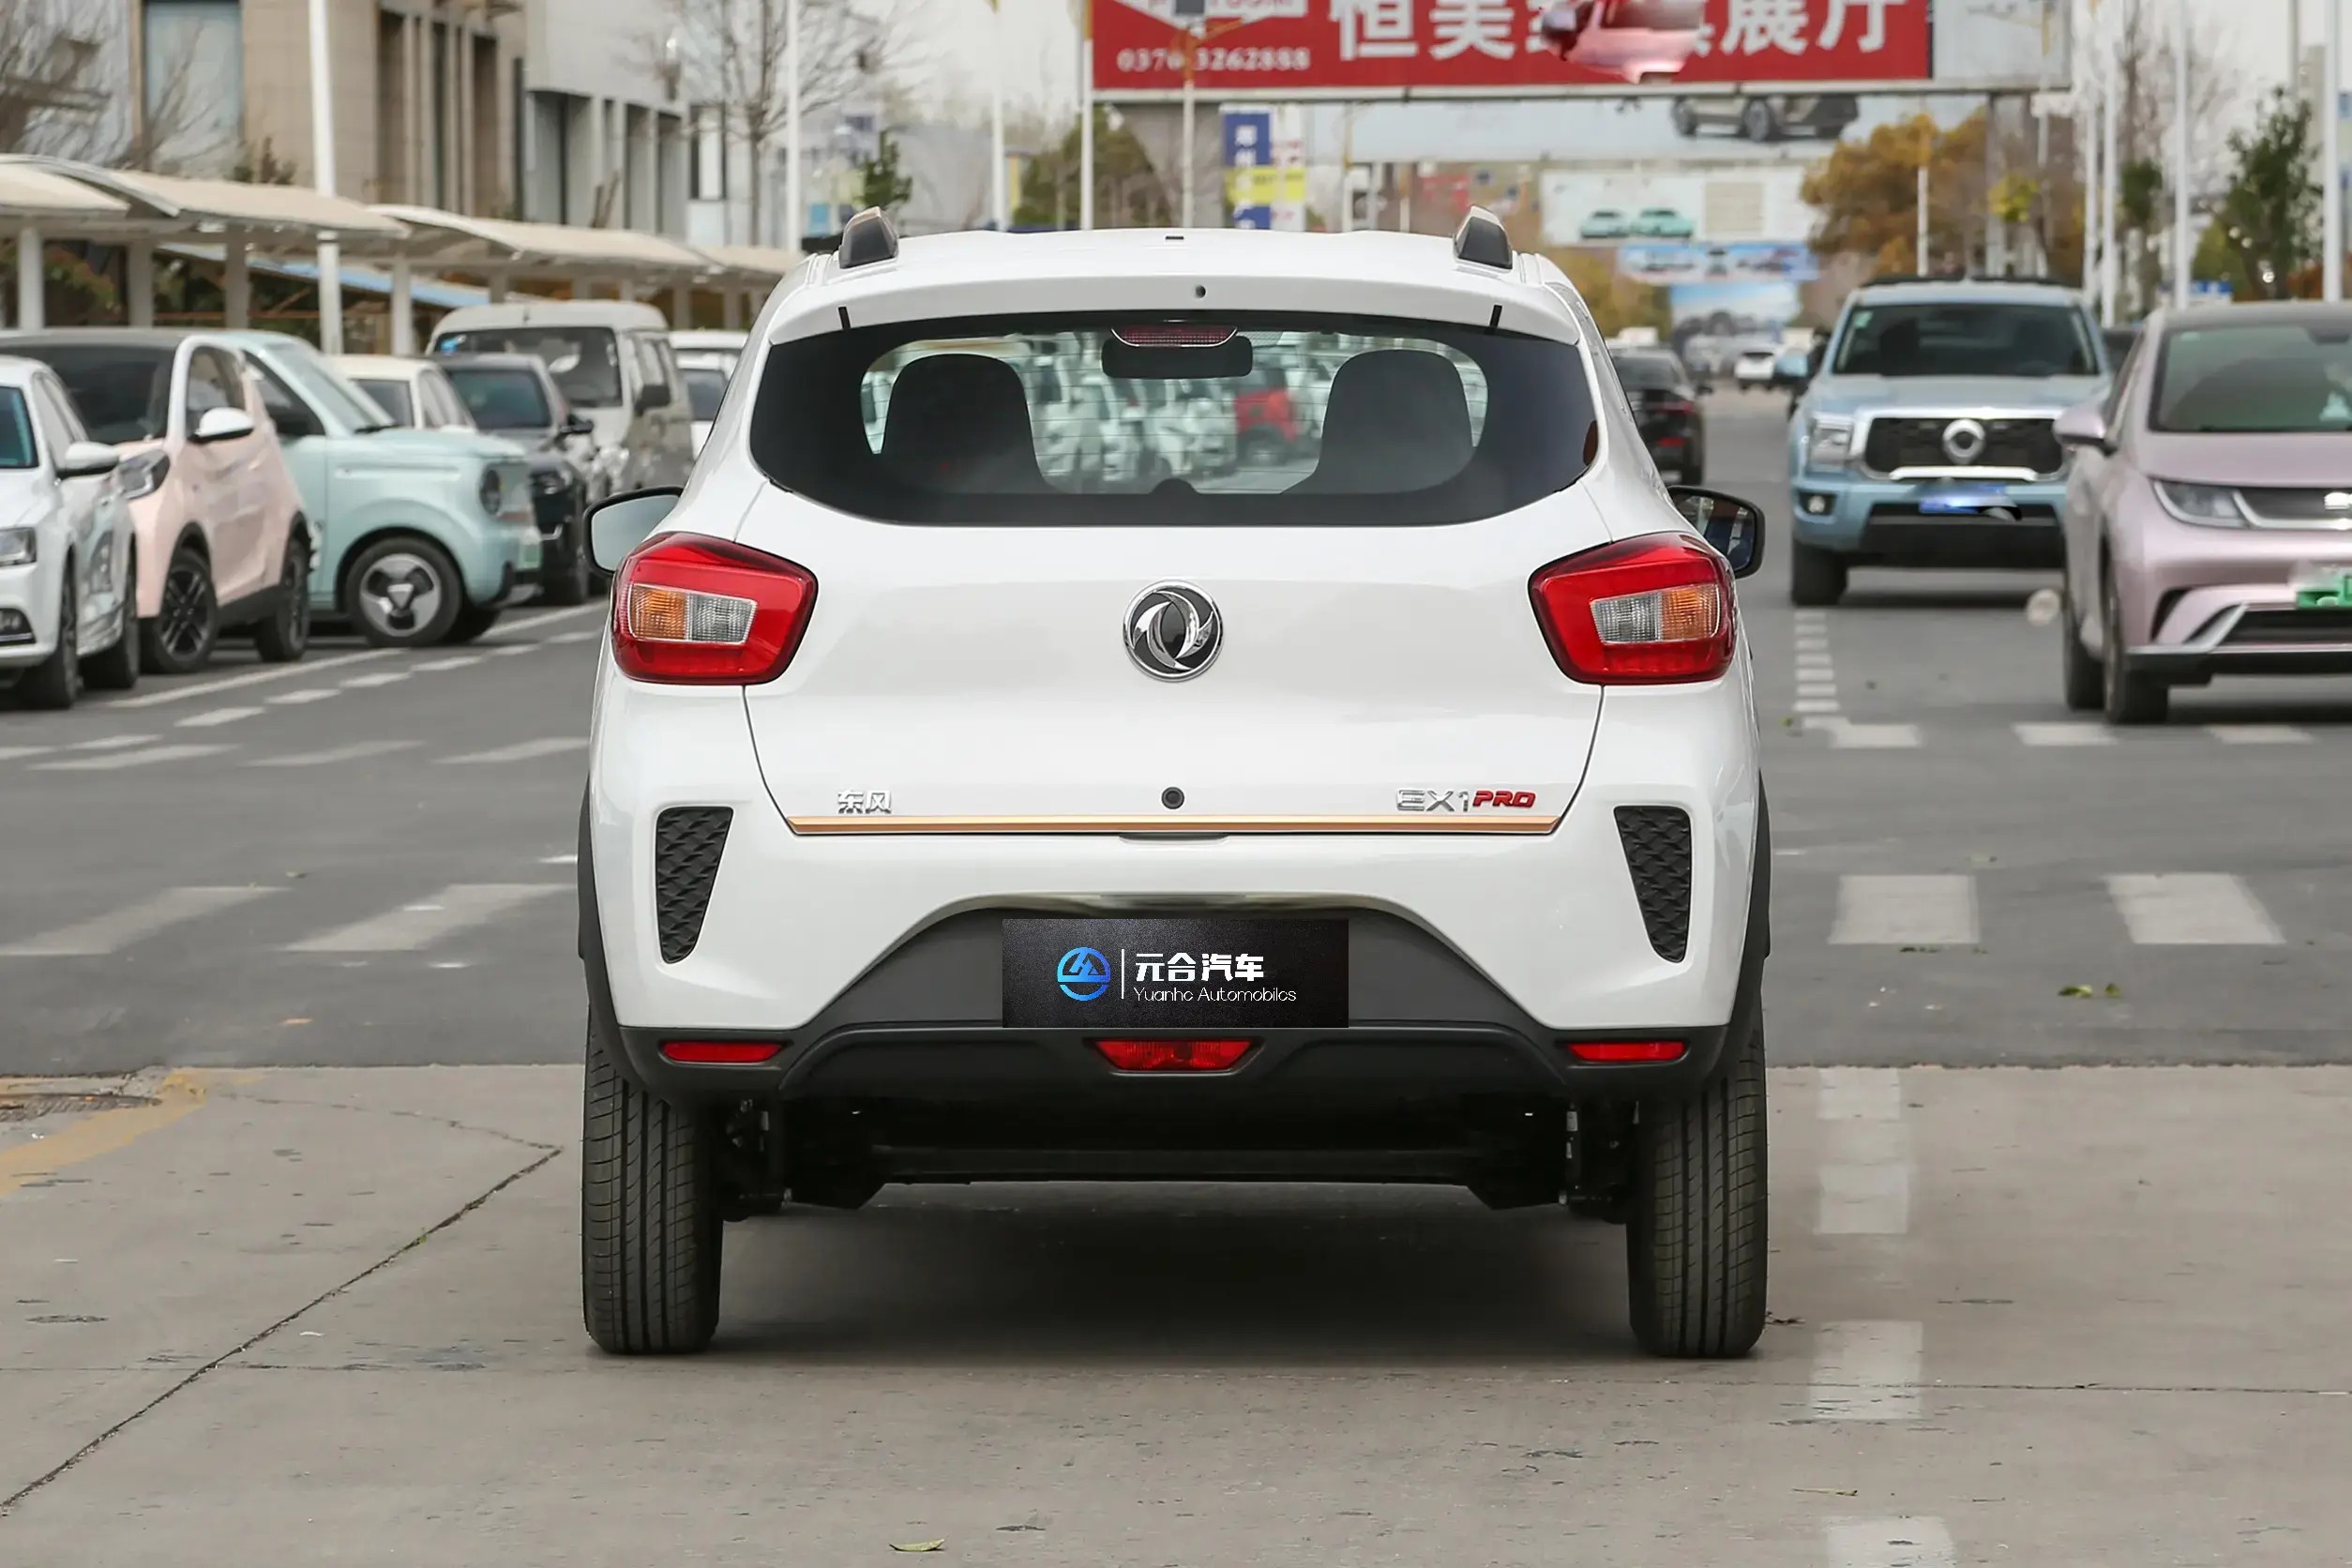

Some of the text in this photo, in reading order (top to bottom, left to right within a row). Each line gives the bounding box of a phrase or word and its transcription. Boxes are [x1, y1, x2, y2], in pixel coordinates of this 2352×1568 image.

[1329, 0, 1907, 60] 恒美展厅
[837, 788, 892, 814] 东风
[1396, 789, 1536, 813] EX1 PRO
